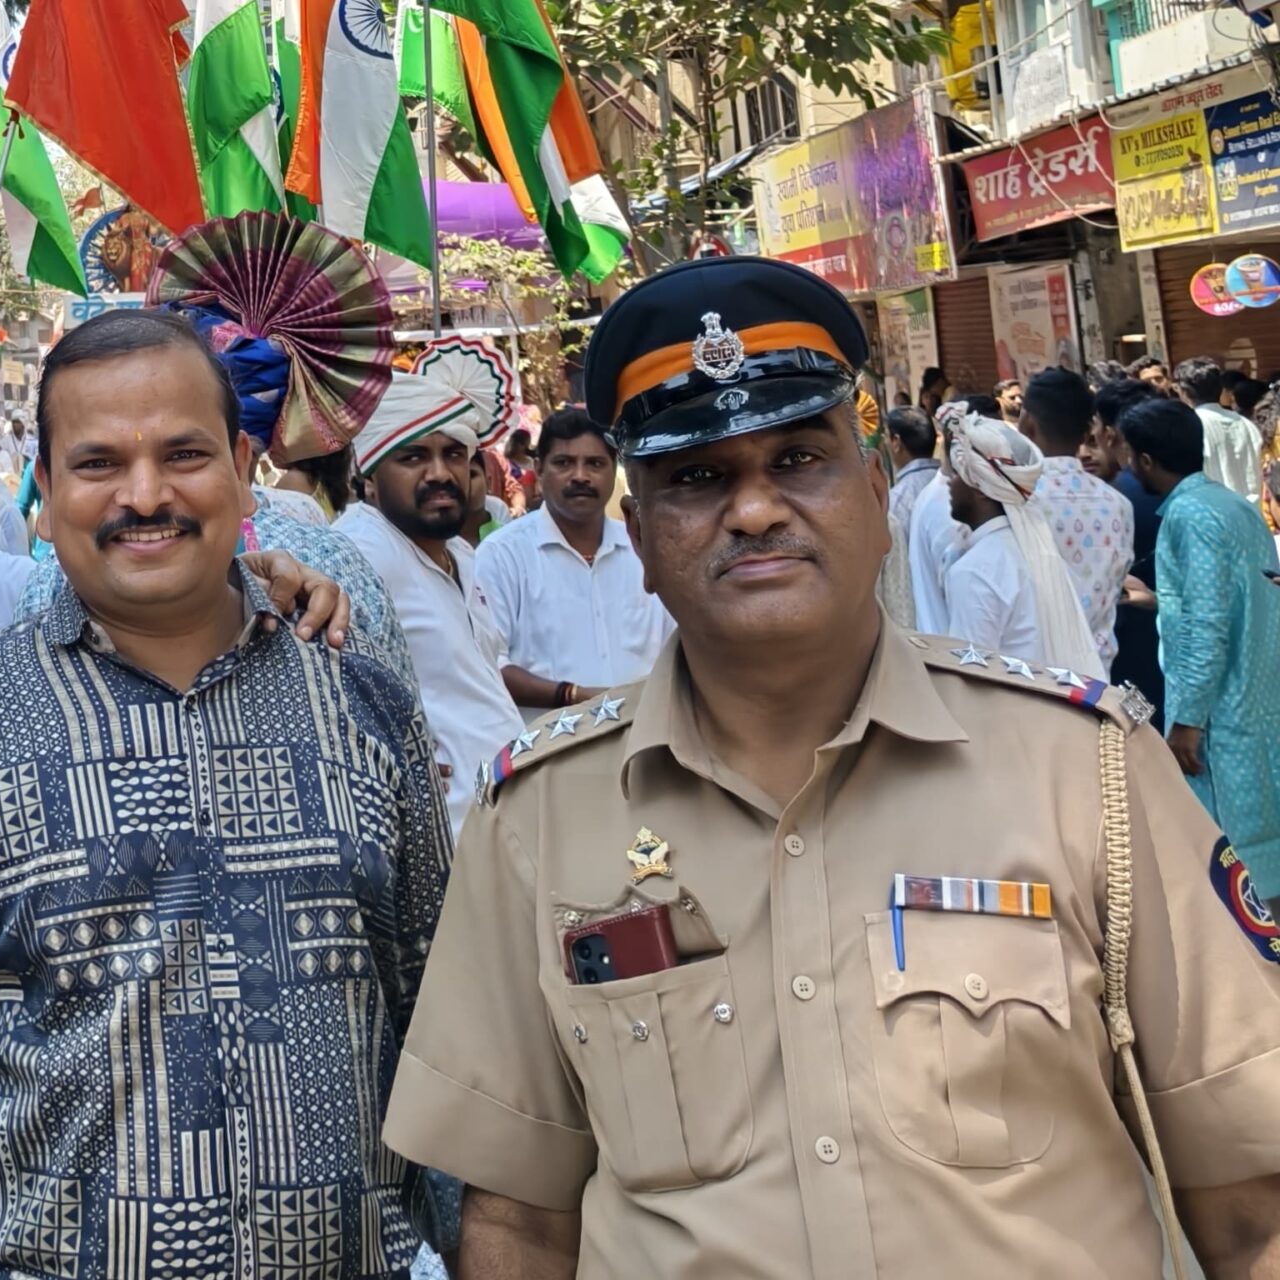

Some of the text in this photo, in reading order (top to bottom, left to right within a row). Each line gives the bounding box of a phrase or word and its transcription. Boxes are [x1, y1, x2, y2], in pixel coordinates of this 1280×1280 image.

[1140, 118, 1197, 149] MILKSHAKE
[777, 156, 838, 200] स्वामी विवेकानंद
[975, 126, 1103, 205] शाह ट्रेडर्स
[781, 214, 795, 243] युवा
